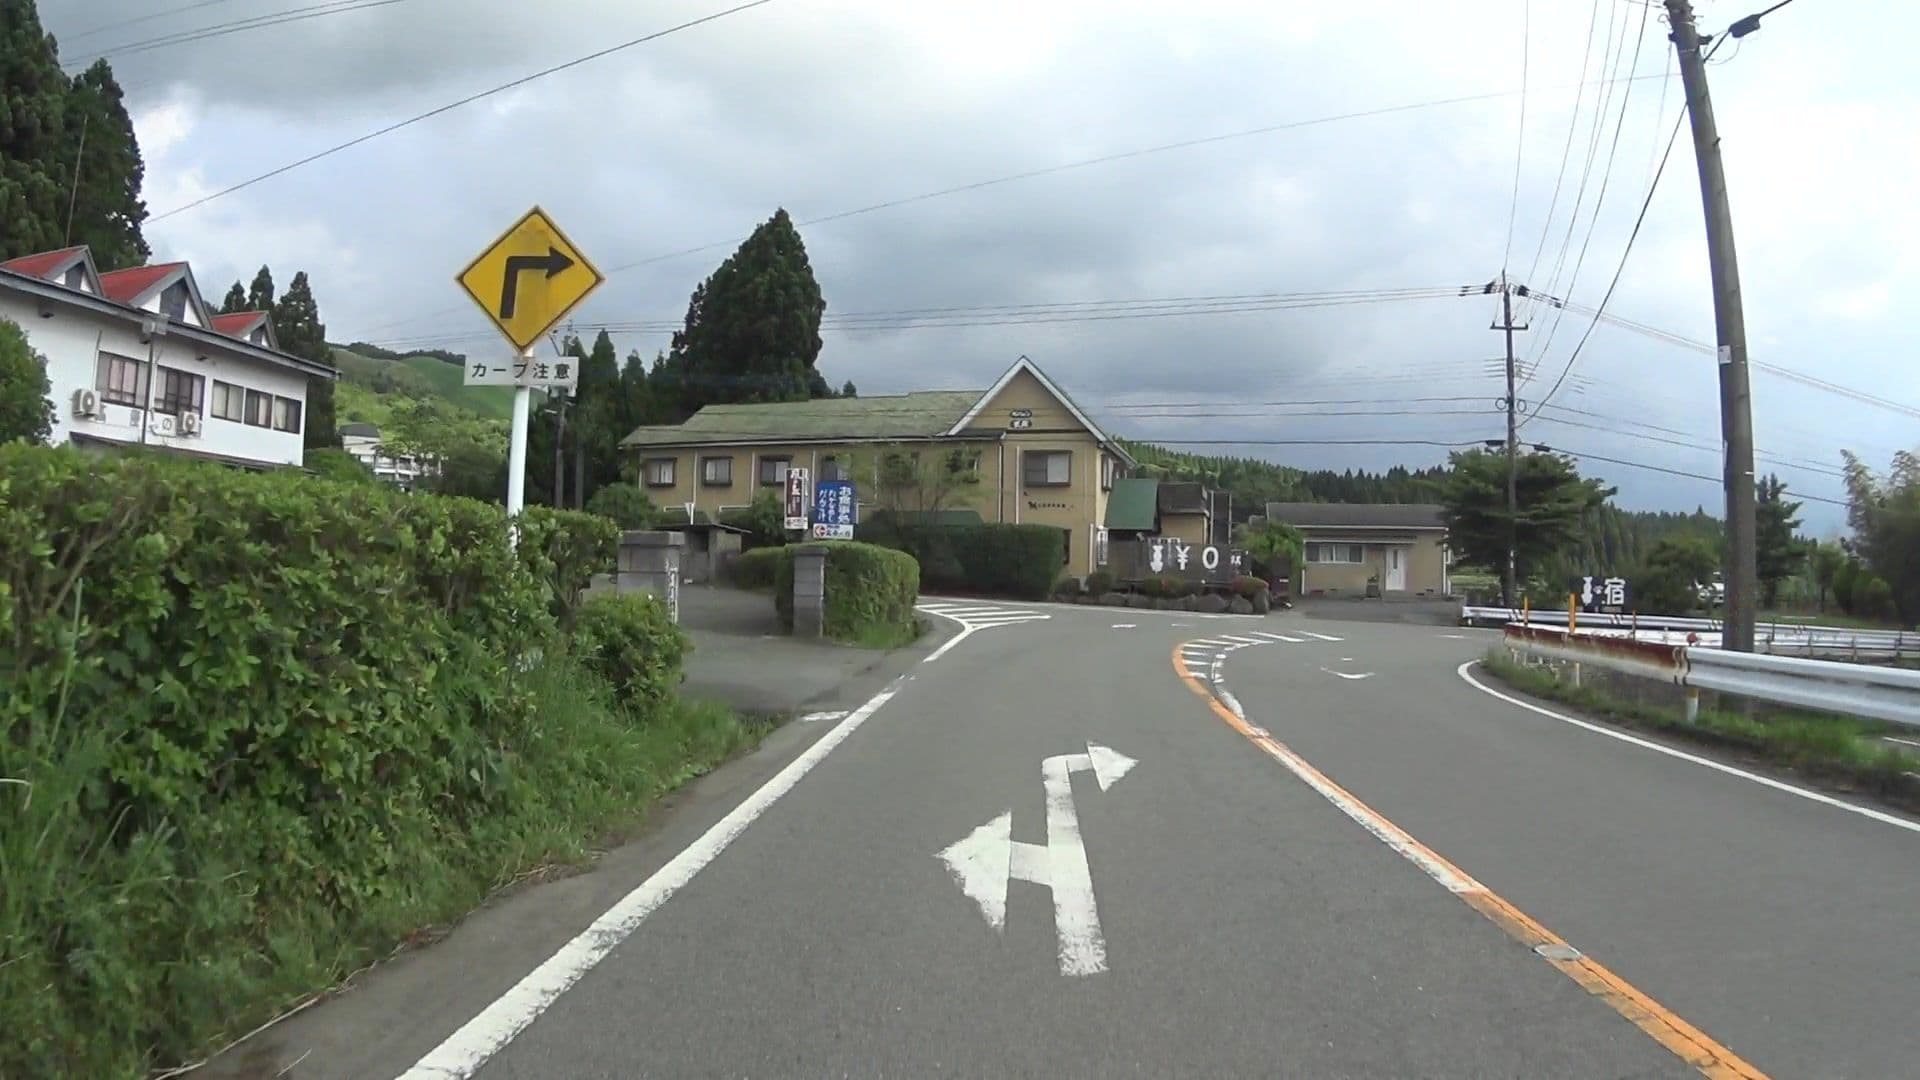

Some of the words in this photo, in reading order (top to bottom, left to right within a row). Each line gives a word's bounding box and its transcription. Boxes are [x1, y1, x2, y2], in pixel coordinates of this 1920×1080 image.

[472, 362, 571, 379] カーブ注意
[1604, 577, 1626, 605] 宿
